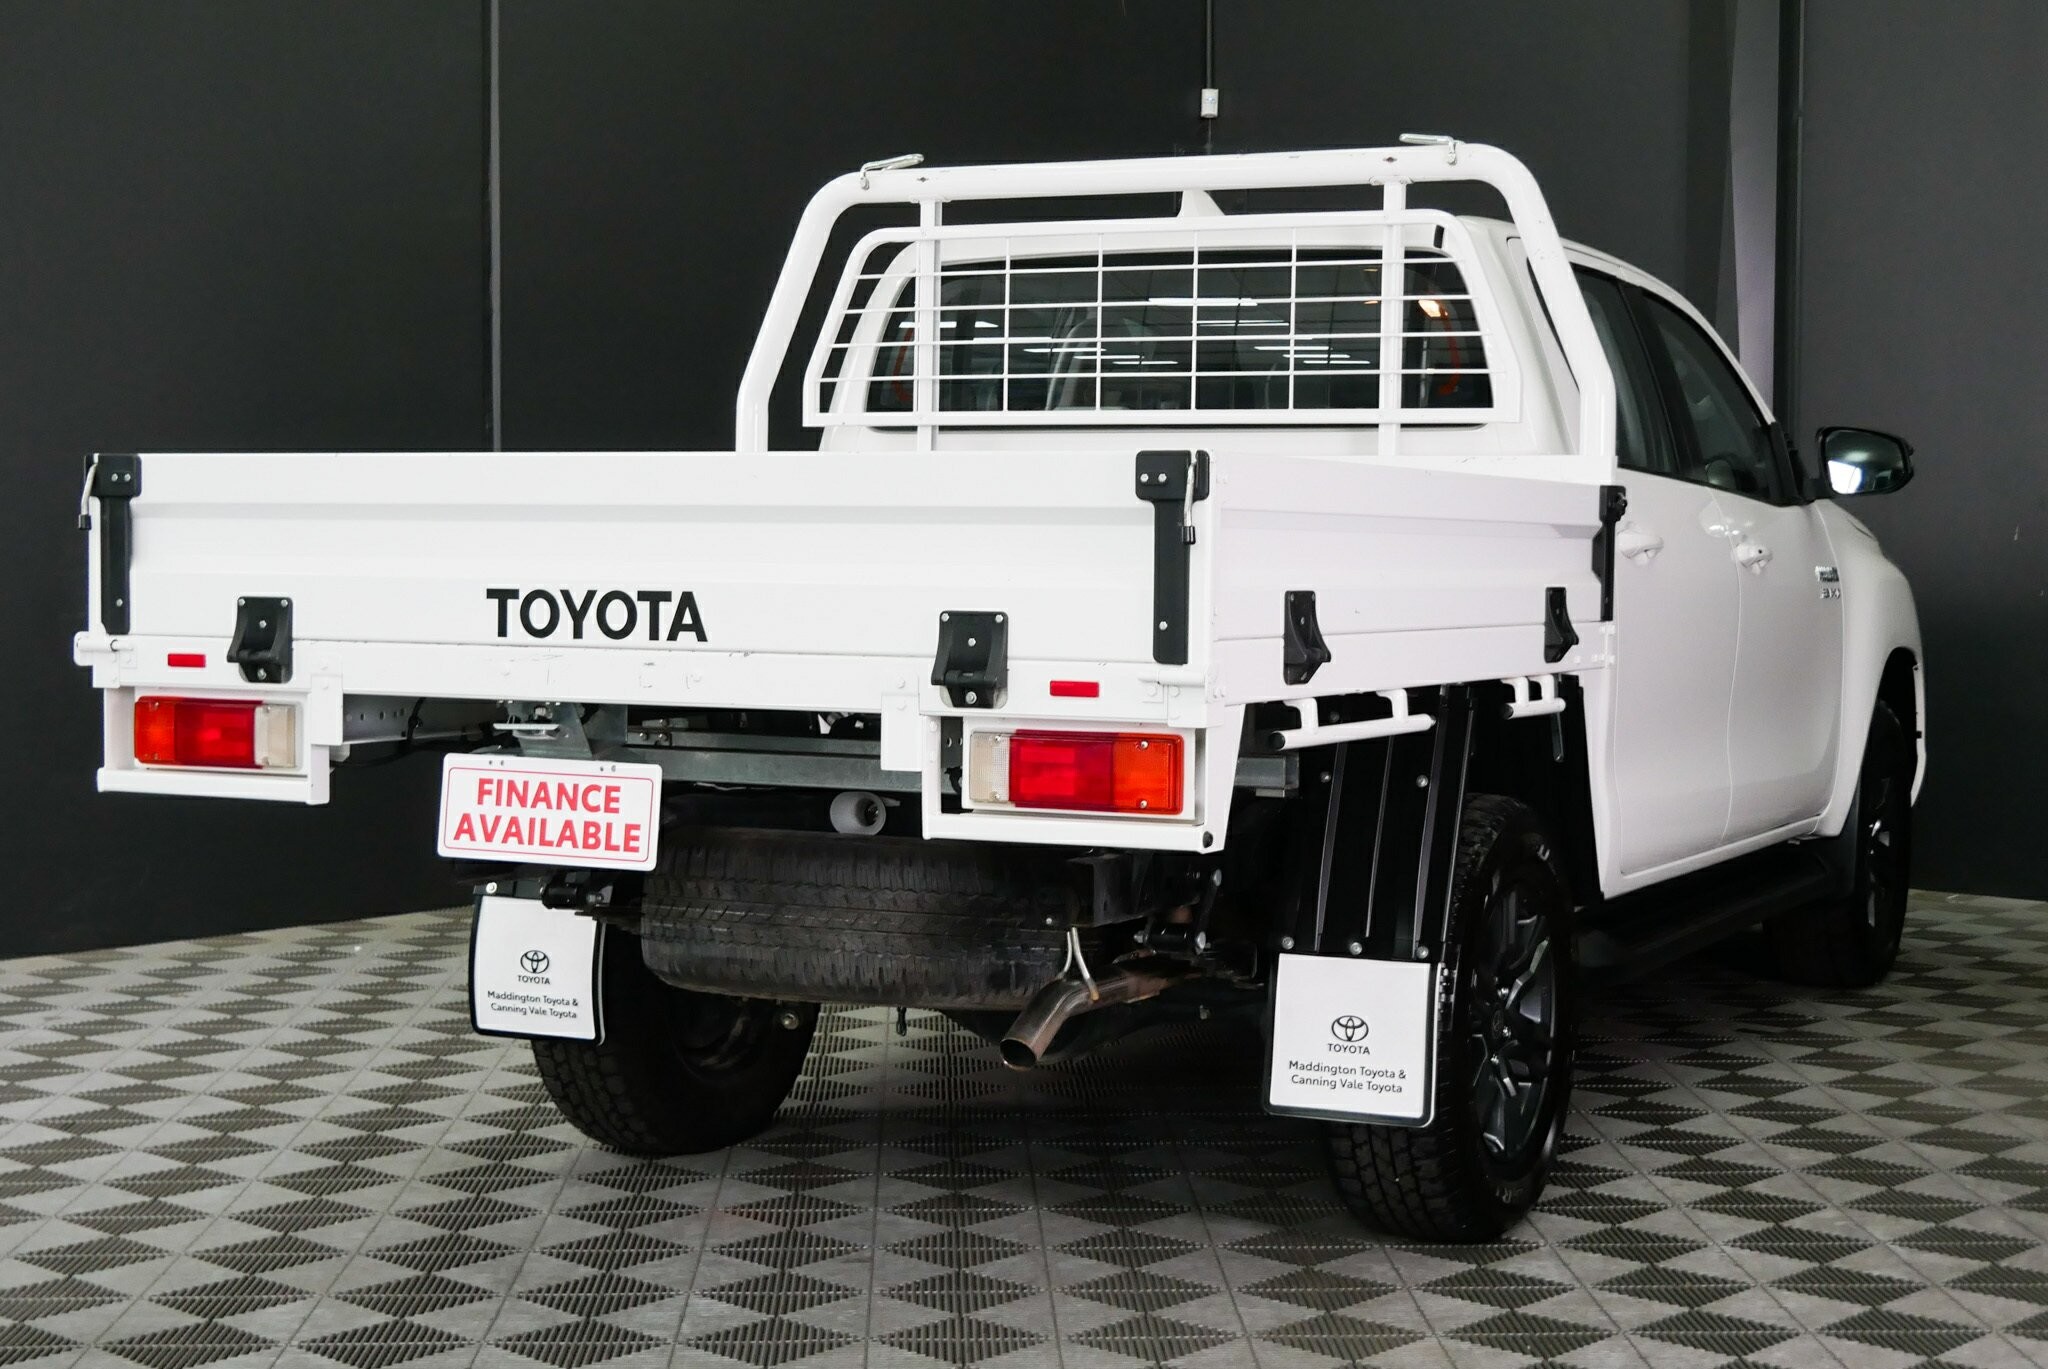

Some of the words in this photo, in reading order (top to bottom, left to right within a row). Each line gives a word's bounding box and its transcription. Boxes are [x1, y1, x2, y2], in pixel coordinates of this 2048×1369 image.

[486, 588, 708, 642] TOYOTA
[477, 777, 621, 814] FINANCE
[453, 813, 641, 853] AVAILABLE
[517, 975, 551, 985] TOYOTA
[487, 990, 541, 1004] Maddington
[543, 995, 570, 1006] Toyota
[572, 999, 579, 1007] &
[490, 1002, 527, 1015] Canning
[529, 1007, 547, 1016] Vale
[549, 1008, 577, 1019] Toyota
[1327, 1043, 1371, 1055] TOYOTA
[1288, 1060, 1357, 1076] Maddington
[1360, 1066, 1396, 1079] Toyota
[1398, 1070, 1407, 1080] &
[1291, 1074, 1337, 1090] Canning
[1340, 1079, 1364, 1090] Vale
[1366, 1081, 1403, 1094] Toyota
